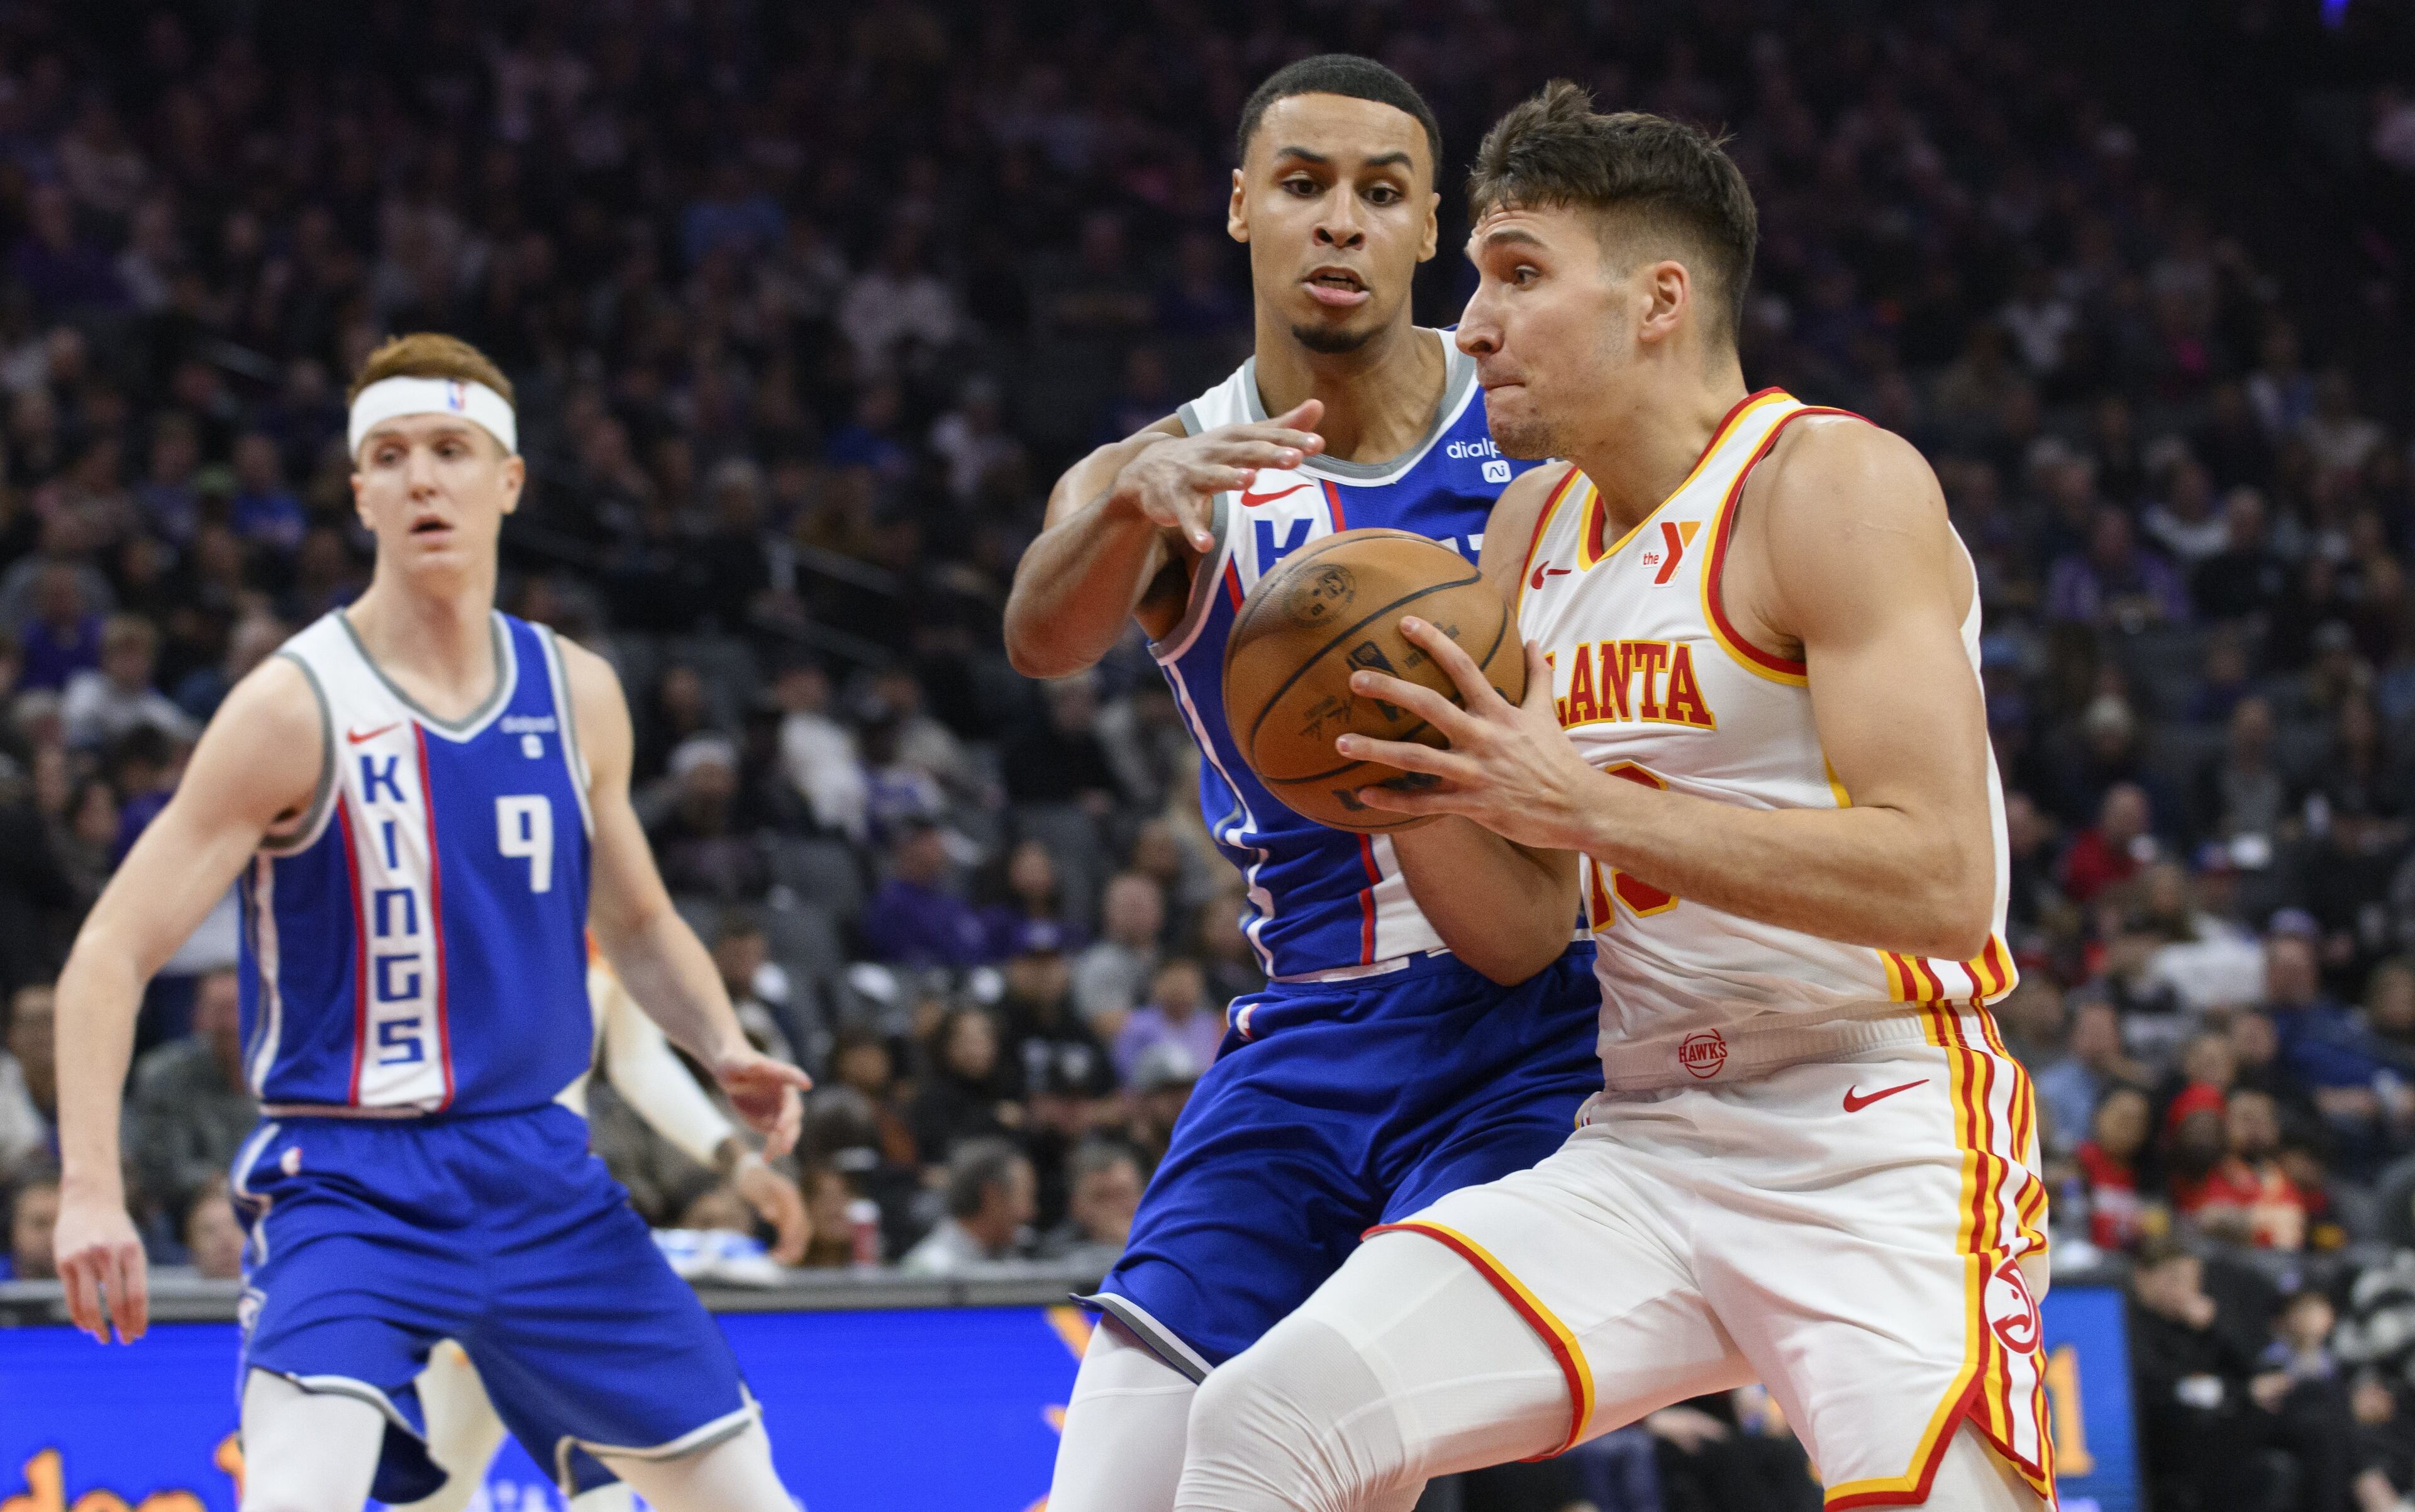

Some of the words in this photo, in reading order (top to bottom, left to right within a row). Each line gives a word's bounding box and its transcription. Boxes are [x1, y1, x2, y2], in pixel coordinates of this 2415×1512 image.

[1446, 438, 1501, 459] dialp
[1643, 552, 1659, 565] the
[1545, 640, 1718, 731] ANTA
[496, 795, 553, 893] 9
[360, 755, 424, 1065] KINGS
[1678, 1041, 1728, 1063] HAWKS
